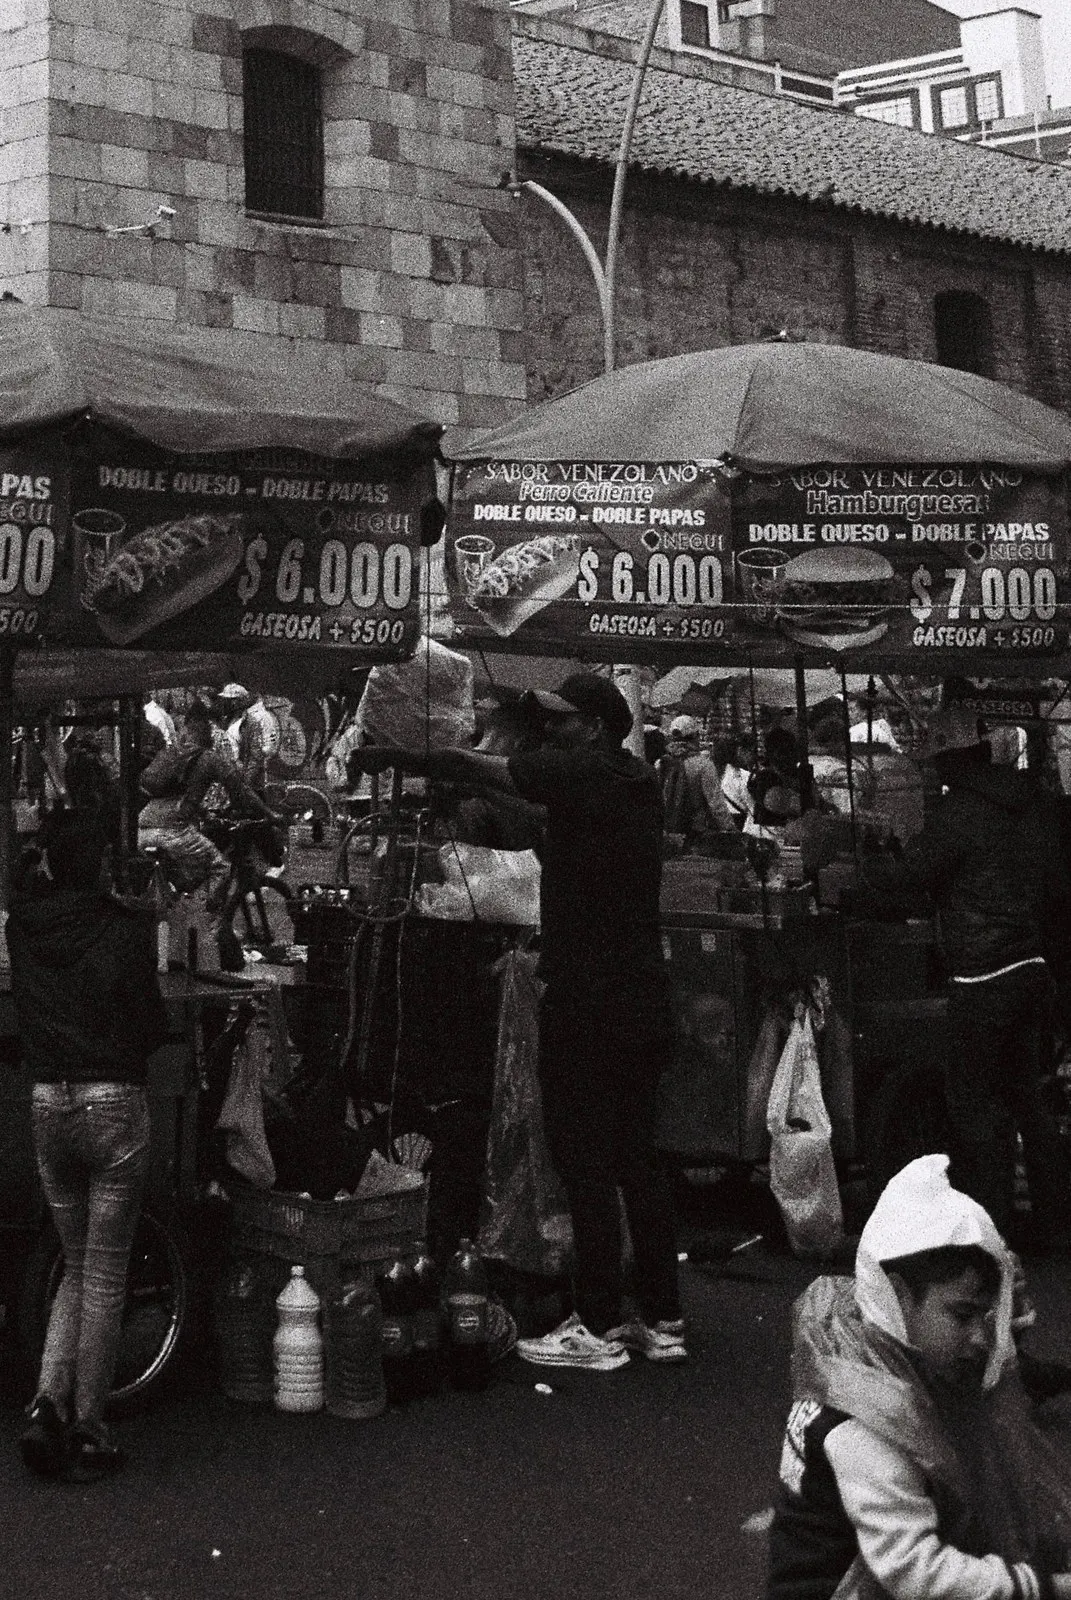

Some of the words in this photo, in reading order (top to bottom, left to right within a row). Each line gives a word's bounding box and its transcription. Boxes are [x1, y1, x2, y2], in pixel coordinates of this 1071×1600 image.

[98, 465, 166, 492] DOBLE
[173, 471, 239, 495] QUESO
[262, 477, 325, 502] DOBLE
[328, 482, 389, 503] PAPAS
[484, 462, 550, 483] SABOR
[557, 463, 698, 484] VENEZOLANO
[518, 482, 571, 502] Perro
[572, 481, 654, 504] Caliente
[473, 504, 521, 521] DOBLE
[525, 505, 576, 523] QUESO
[592, 507, 645, 525] DOBLE
[648, 508, 706, 526] PAPAS
[806, 490, 989, 522] Hamburguesas
[749, 523, 816, 542] DOBLE
[821, 523, 889, 543] QUESO
[912, 523, 976, 543] DOBLE
[982, 522, 1049, 542] PAPAS
[240, 611, 322, 640] GASEOSA
[350, 618, 404, 643] $500
[589, 613, 657, 636] GASEOSA
[680, 618, 725, 638] $500
[912, 626, 988, 647] GASEOSA
[1012, 627, 1055, 646] $500
